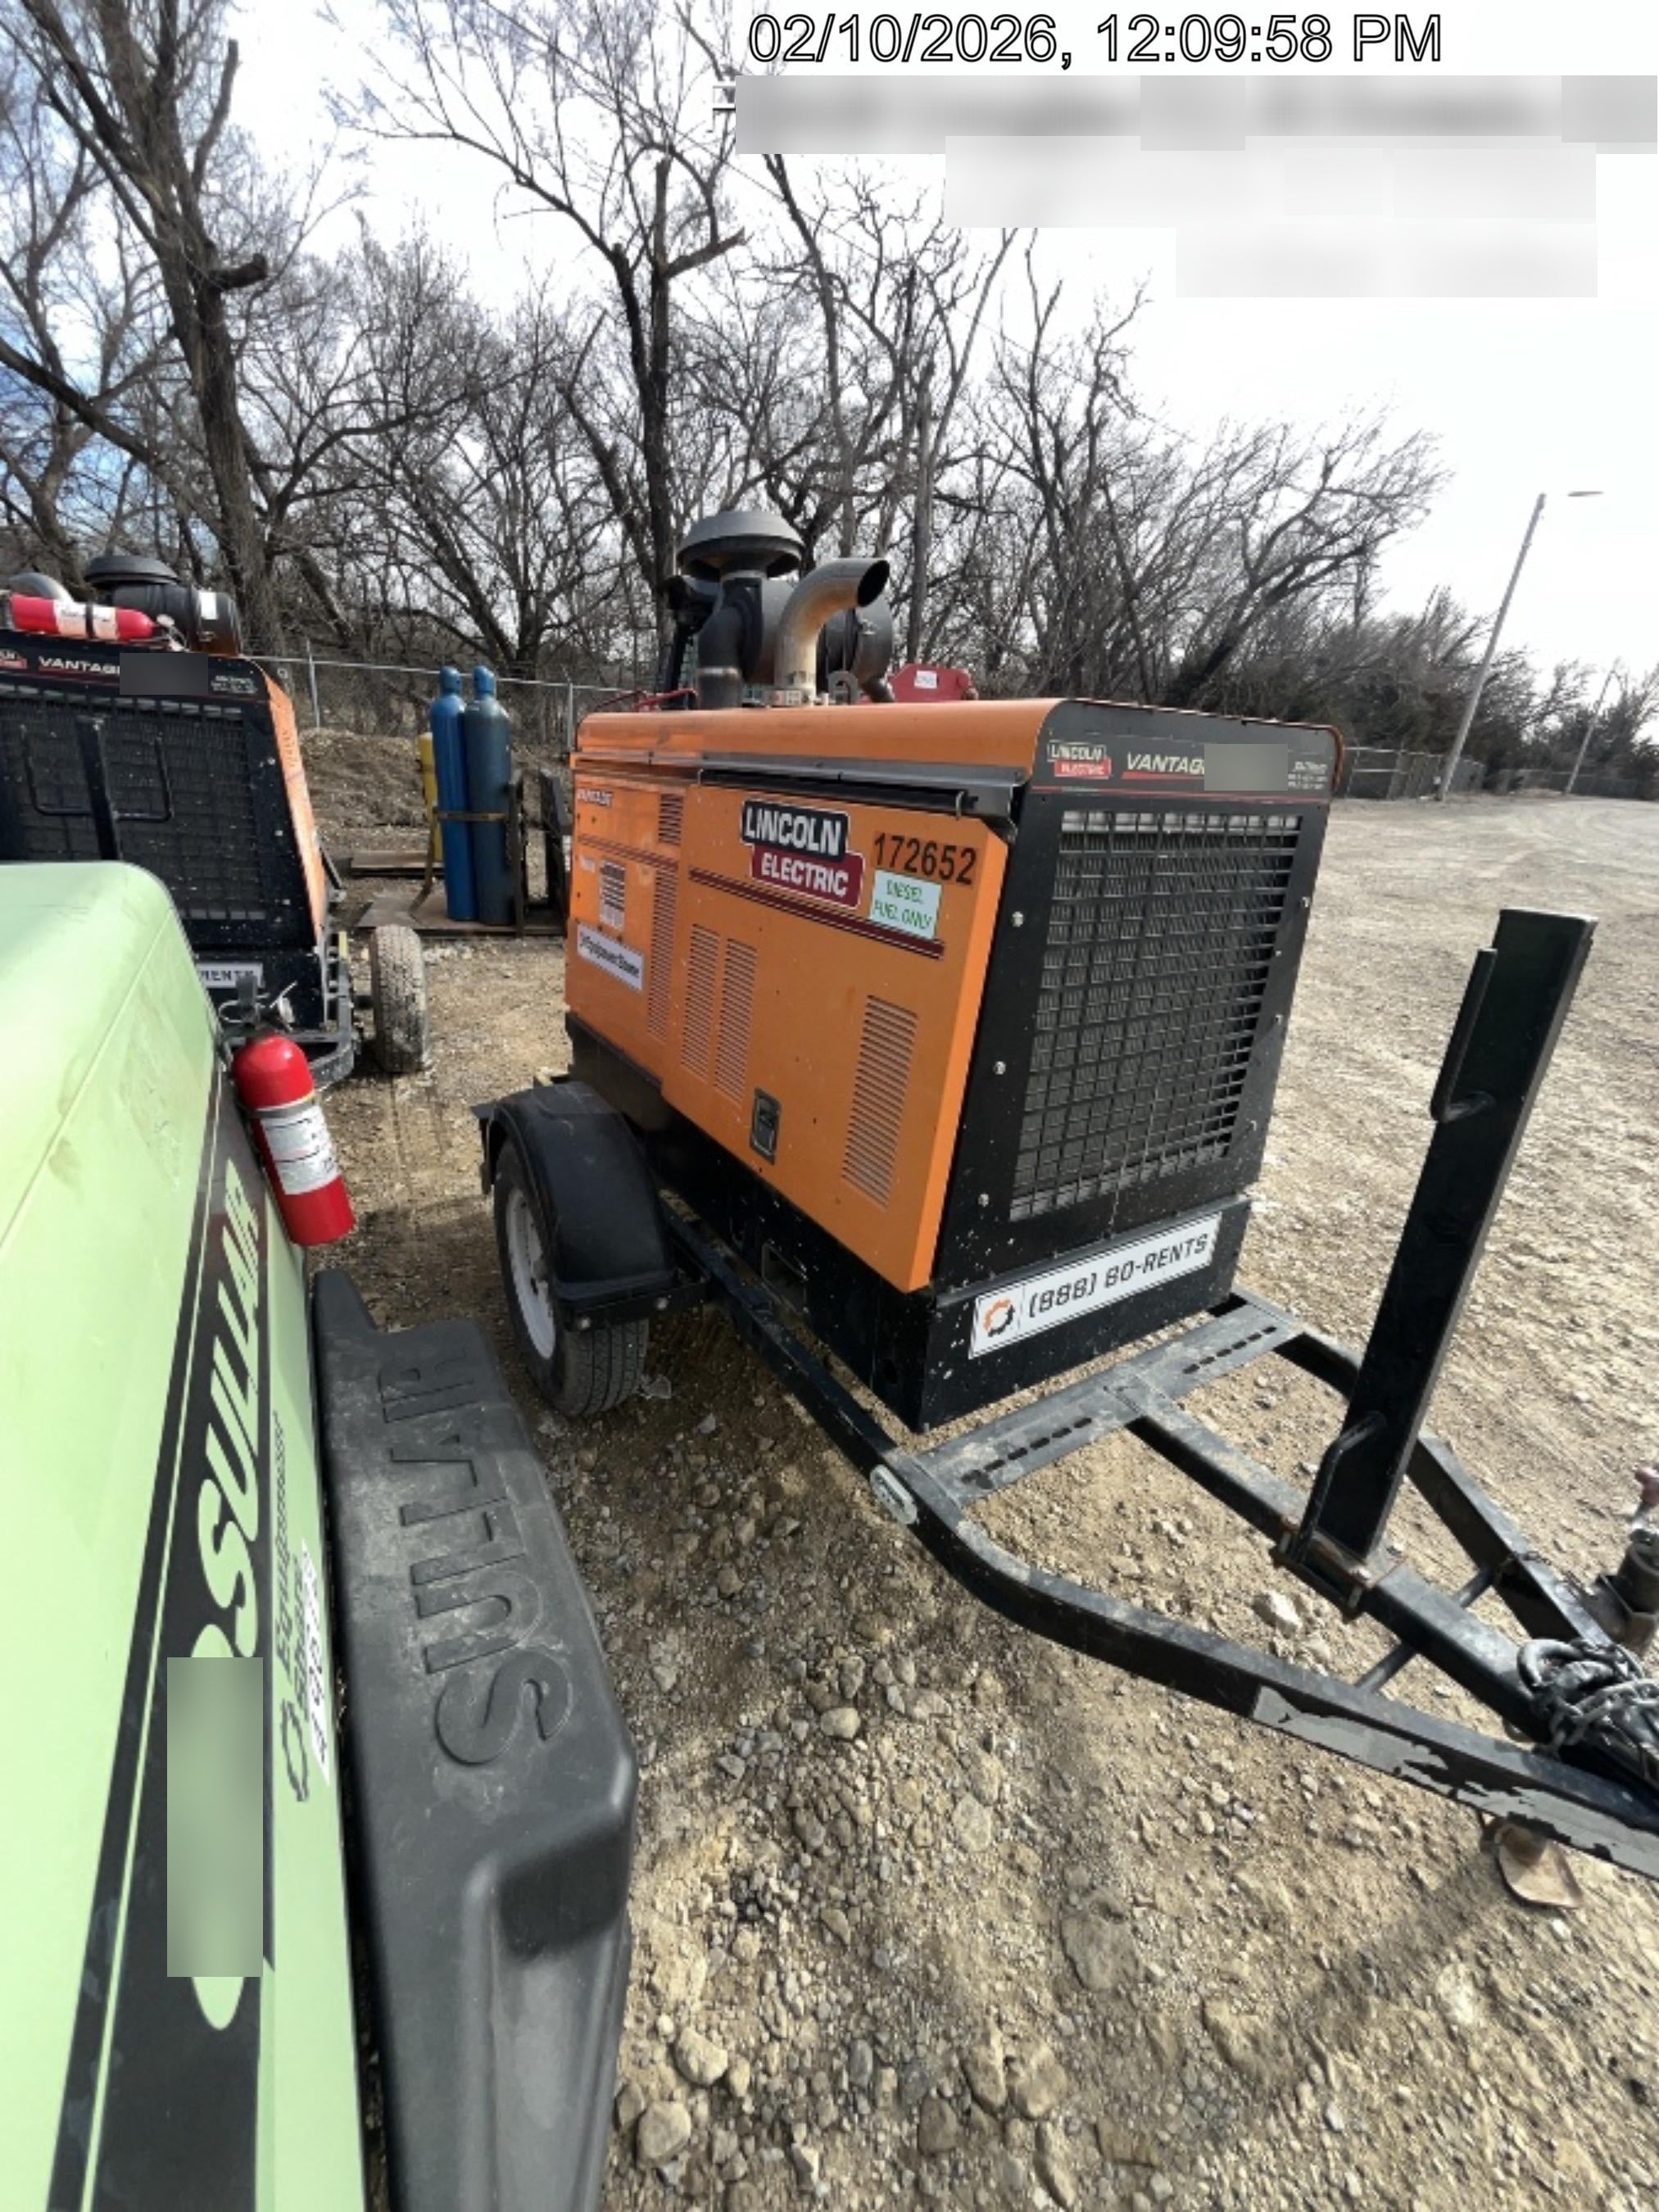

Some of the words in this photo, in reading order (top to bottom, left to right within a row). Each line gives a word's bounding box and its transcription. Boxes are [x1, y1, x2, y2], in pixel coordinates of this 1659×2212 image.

[1051, 744, 1103, 762] LINCOLN
[745, 805, 842, 855] LINCOLN
[761, 852, 849, 898] ELECTRIC
[874, 832, 977, 885] 172652
[874, 899, 900, 921] FUEL
[901, 908, 932, 930] ONLY
[886, 879, 924, 904] DIESEL
[1029, 1272, 1097, 1318] (888)
[1105, 1233, 1208, 1289] 80-RENTS
[197, 1157, 258, 1658] SULLAIR
[378, 1349, 573, 1766] SULLAIR
